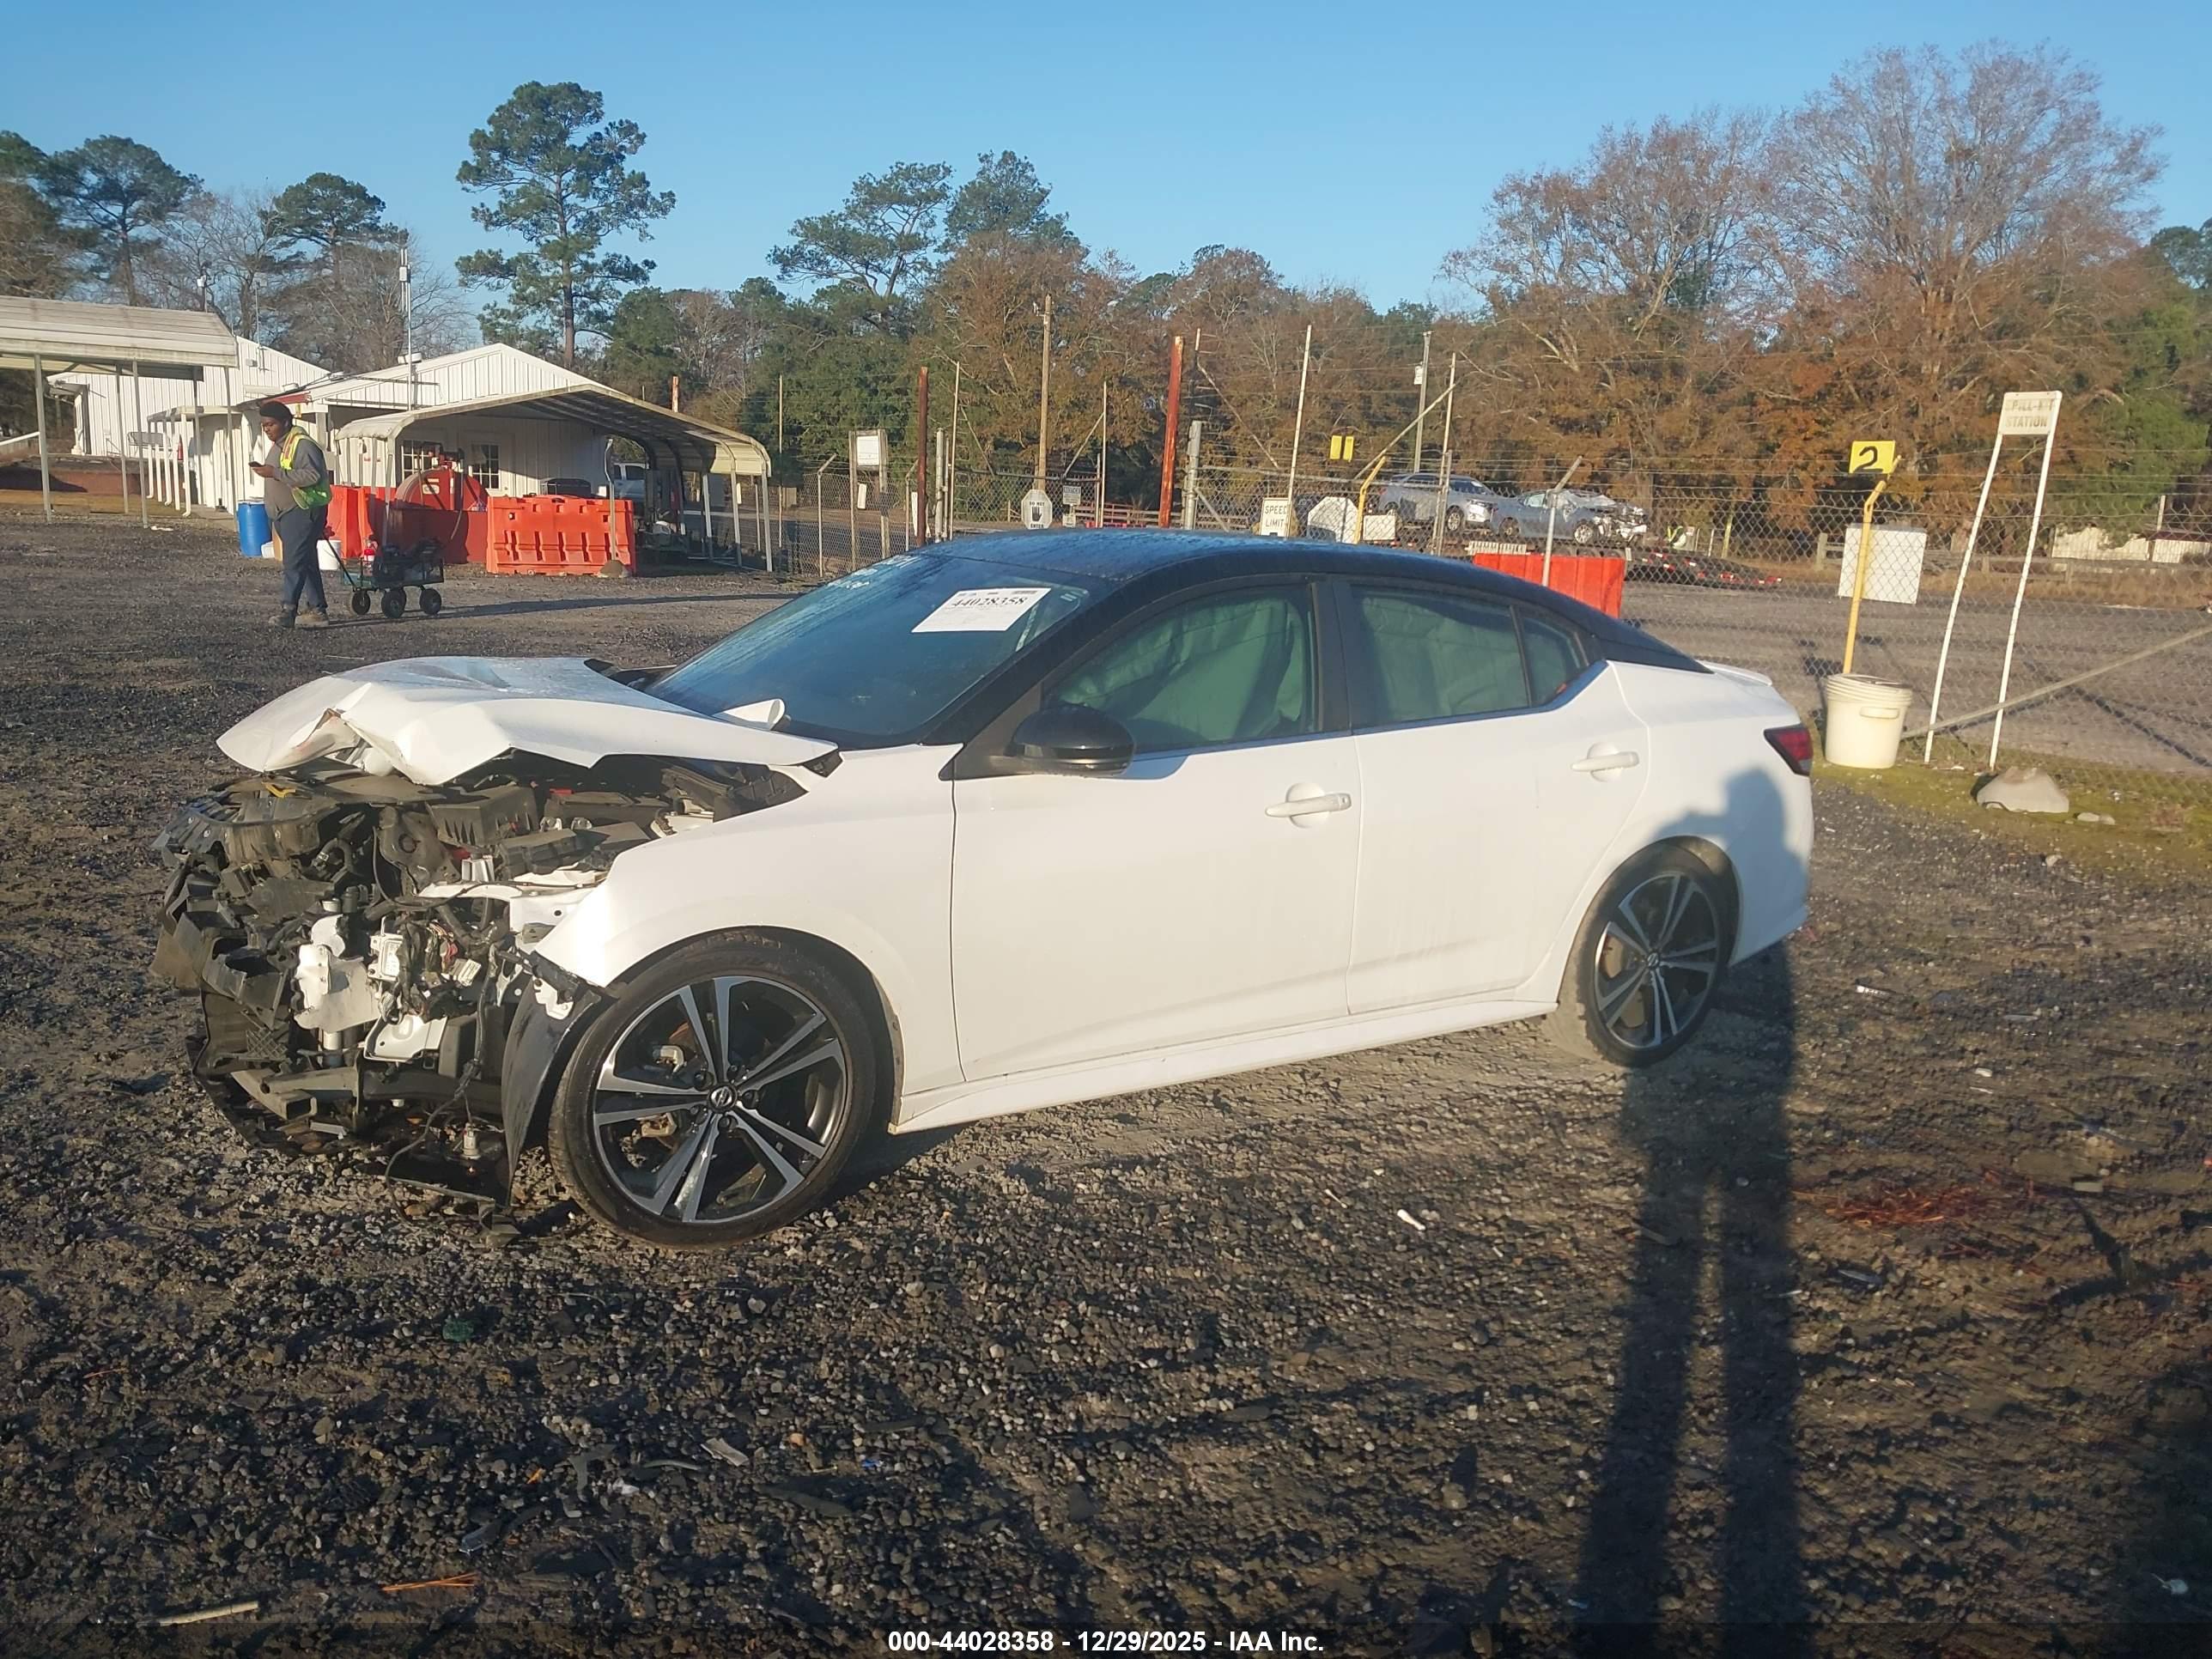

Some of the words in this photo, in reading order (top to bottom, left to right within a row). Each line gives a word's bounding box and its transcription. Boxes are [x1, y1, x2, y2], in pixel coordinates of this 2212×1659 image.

[2005, 416, 2048, 428] STATION
[1854, 446, 1883, 473] 2
[1265, 518, 1285, 527] LIMIT
[951, 597, 1029, 606] 44028358
